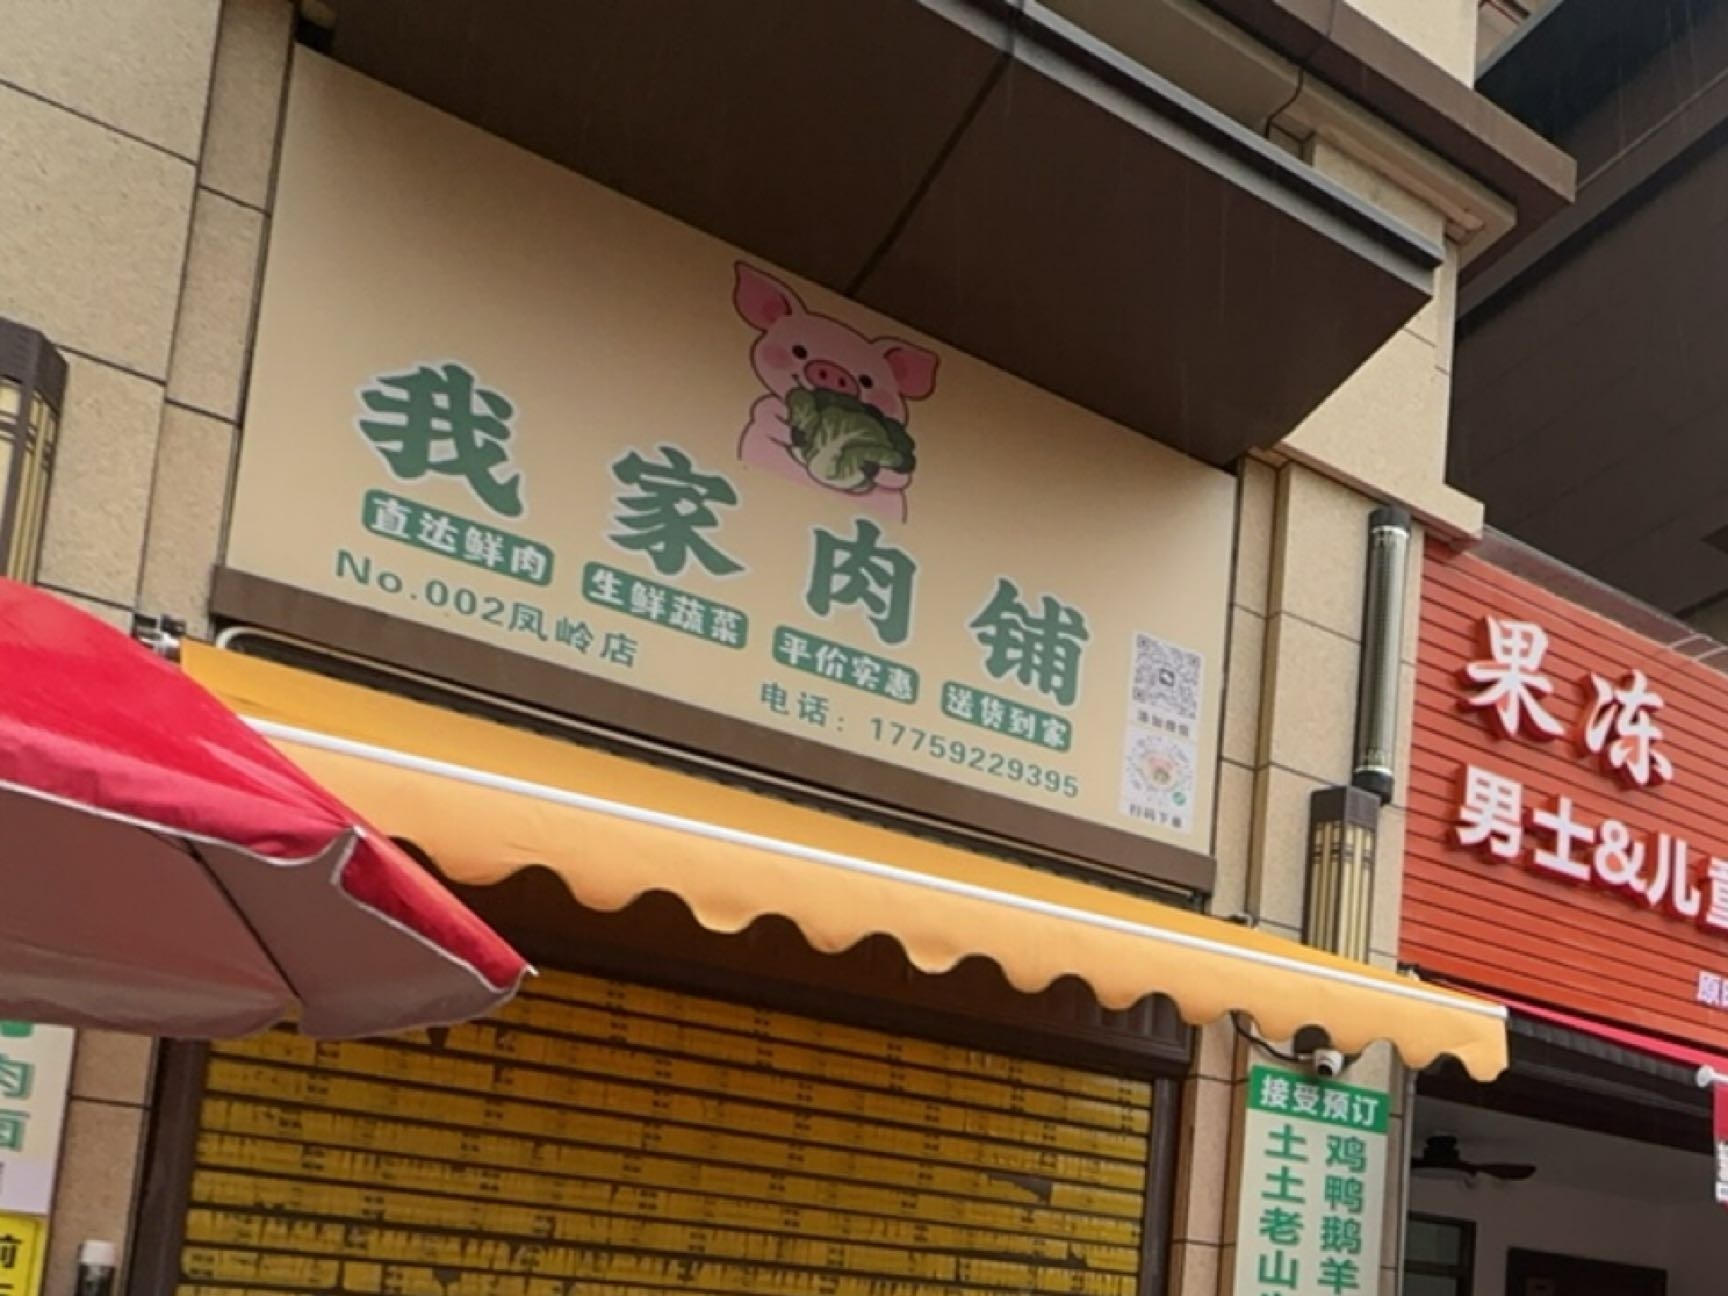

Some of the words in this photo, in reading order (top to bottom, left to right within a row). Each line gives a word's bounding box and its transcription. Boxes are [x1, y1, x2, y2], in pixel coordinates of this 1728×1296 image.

[359, 363, 1089, 709] 我家肉铺
[372, 498, 546, 581] 直达鲜肉
[589, 569, 743, 644] 生鲜蔬菜
[782, 632, 915, 701] 平价实惠
[946, 687, 1068, 750] 送货到家
[1465, 615, 1674, 785] 果冻
[1261, 1075, 1379, 1127] 接受预订
[1265, 1124, 1367, 1173] 土鸡
[1261, 1167, 1365, 1214] 土鸭
[1259, 1208, 1363, 1254] 老鹅
[1258, 1252, 1360, 1296] 山羊
